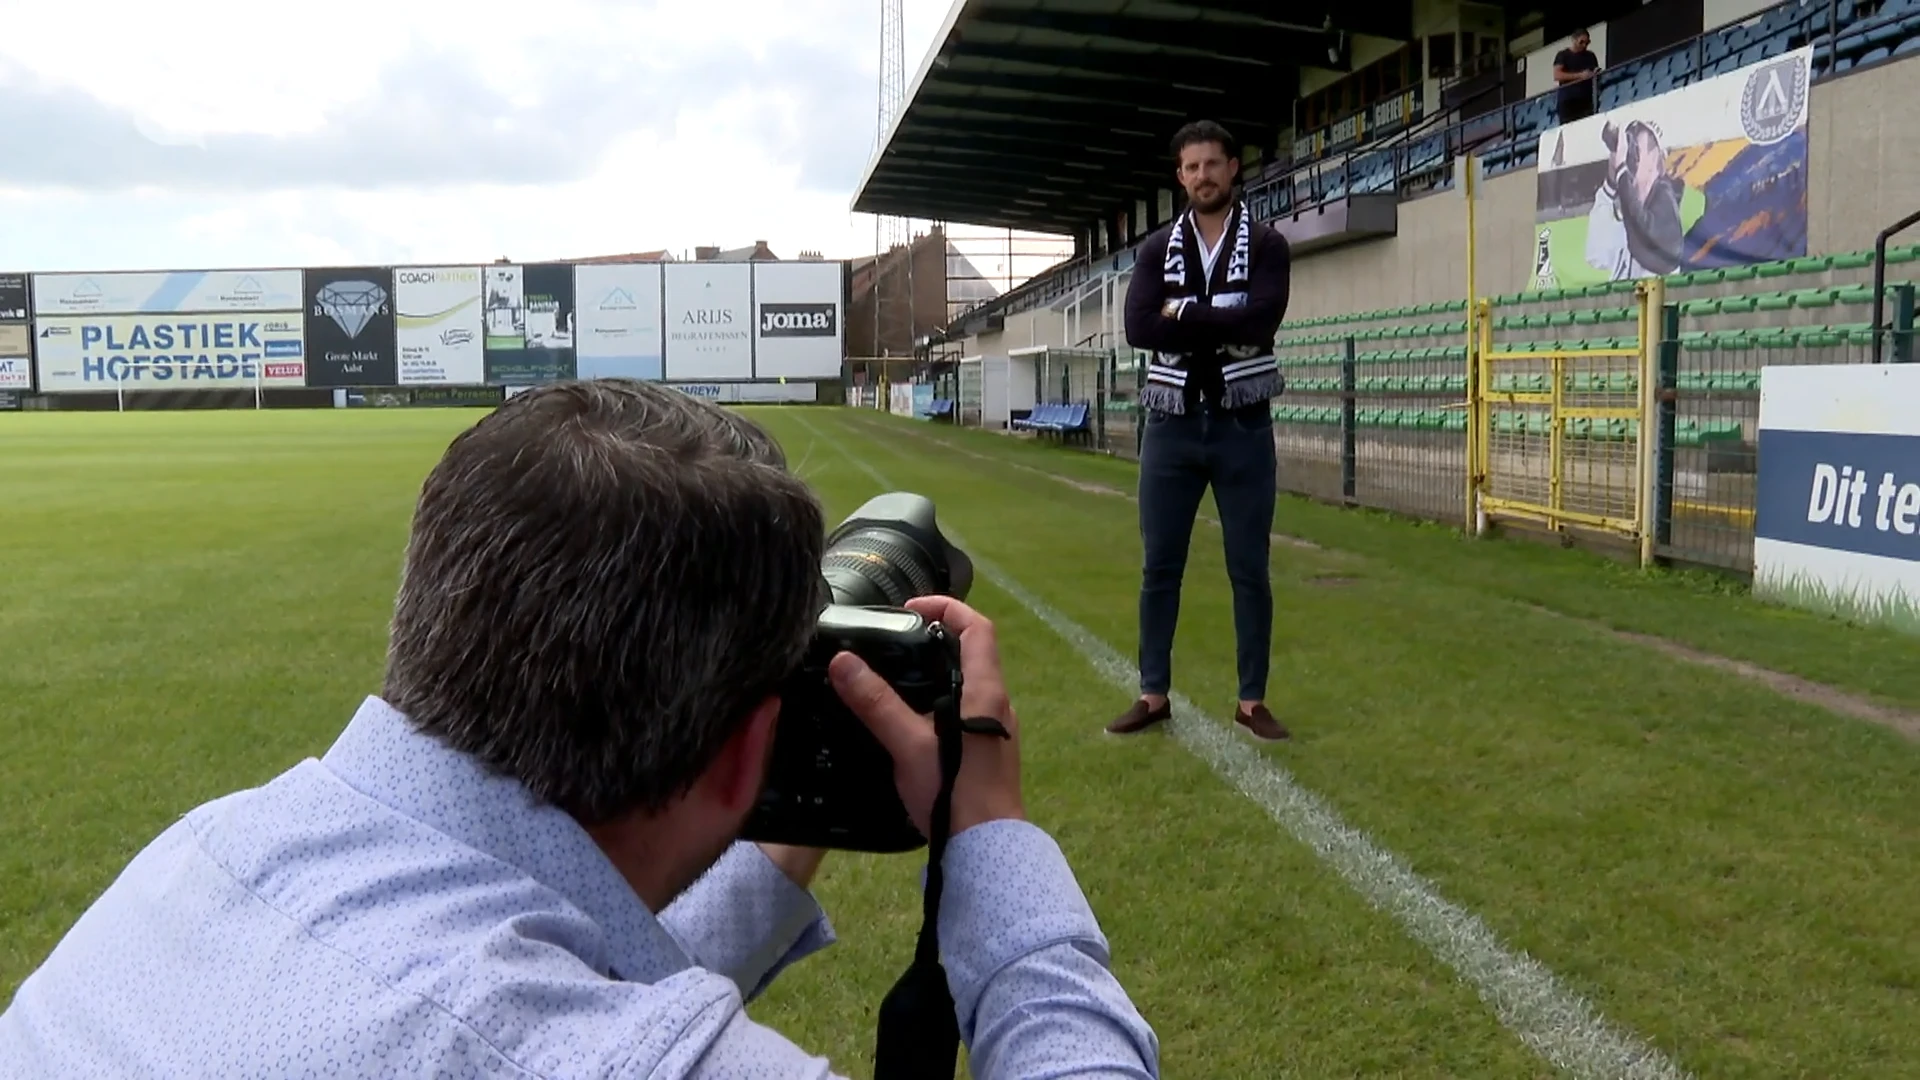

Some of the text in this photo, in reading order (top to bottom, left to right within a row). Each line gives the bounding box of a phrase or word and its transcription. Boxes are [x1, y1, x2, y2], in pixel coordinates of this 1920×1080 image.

[682, 309, 733, 325] ARIJS
[81, 322, 262, 350] PLASTIEK
[83, 353, 261, 381] HOFSTADE
[268, 366, 300, 375] VELUX
[1807, 462, 1920, 536] Dit te
